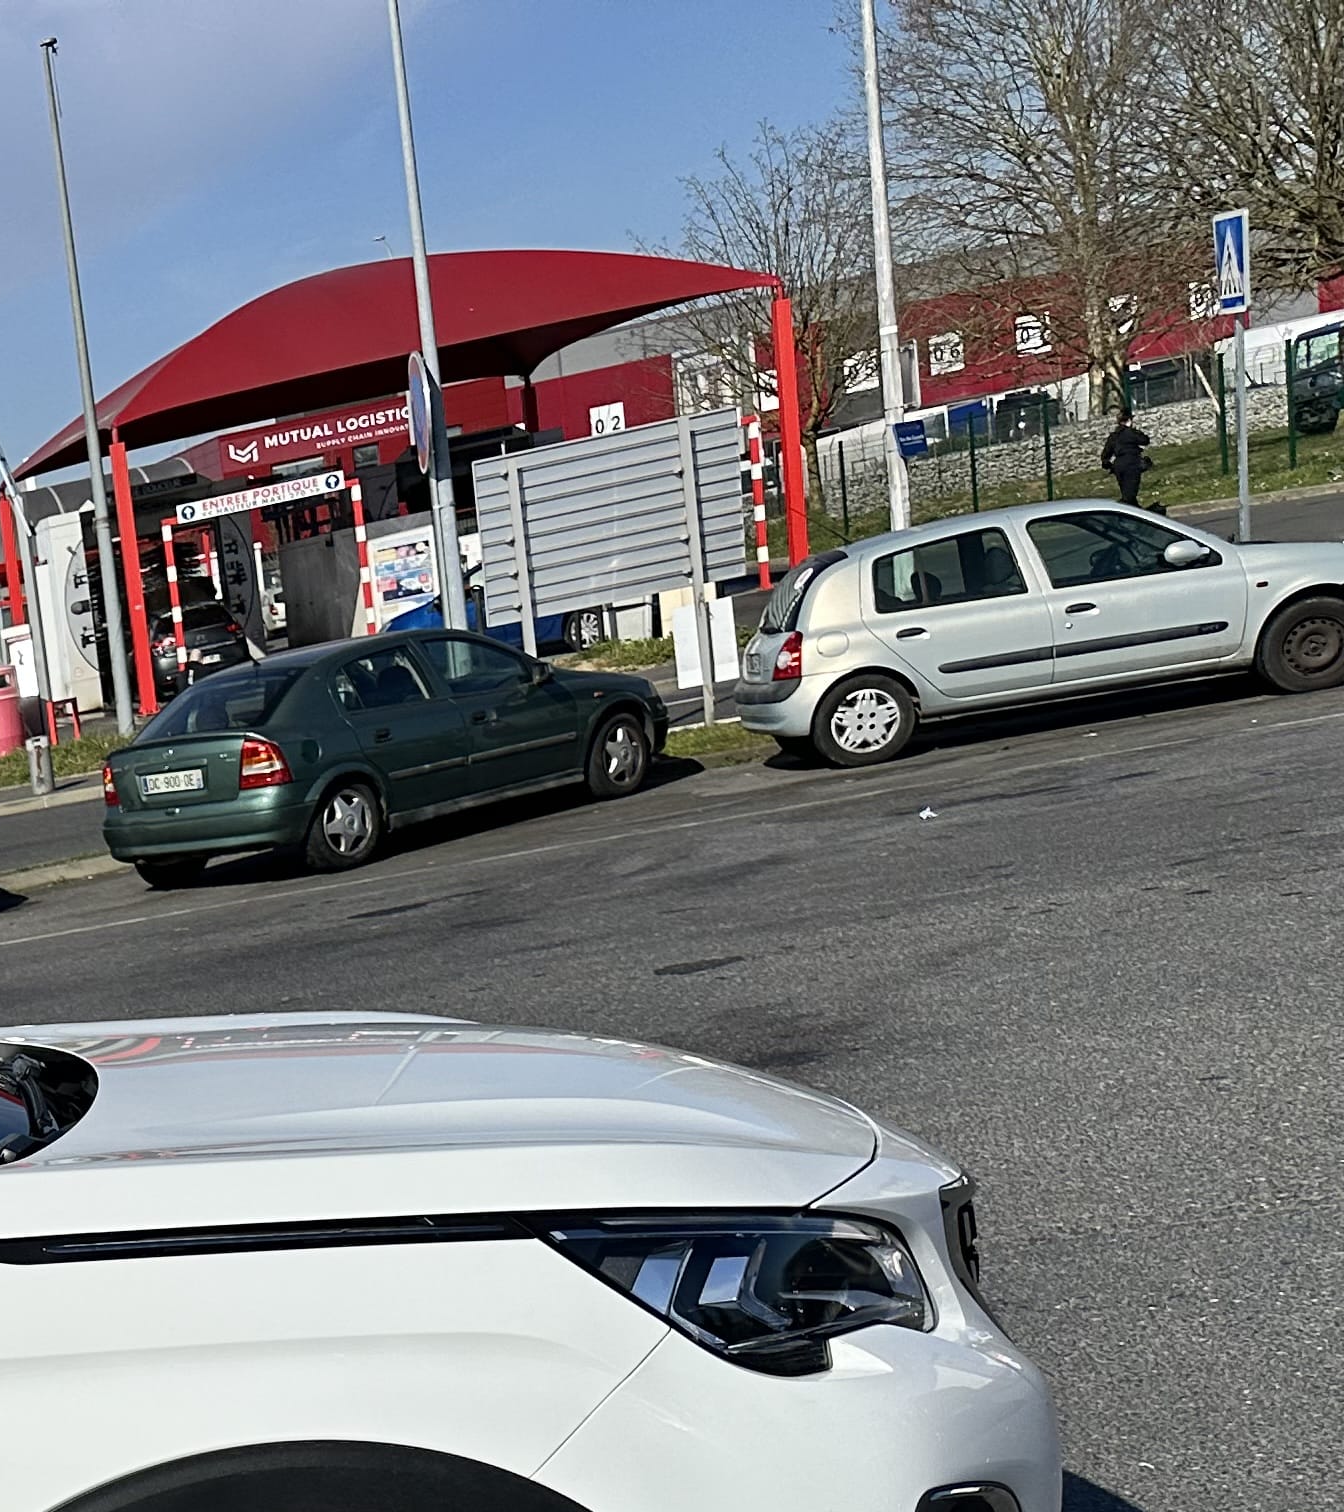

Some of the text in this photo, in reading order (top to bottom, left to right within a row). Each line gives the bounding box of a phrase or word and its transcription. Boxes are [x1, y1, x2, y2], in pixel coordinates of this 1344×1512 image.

[264, 406, 411, 449] MUTUAL LOGISTIC
[316, 423, 409, 449] SUPPLY CHAIN INNOVAT
[202, 478, 319, 511] ENTREE PORTIQUE
[217, 501, 257, 514] HAUTEUR
